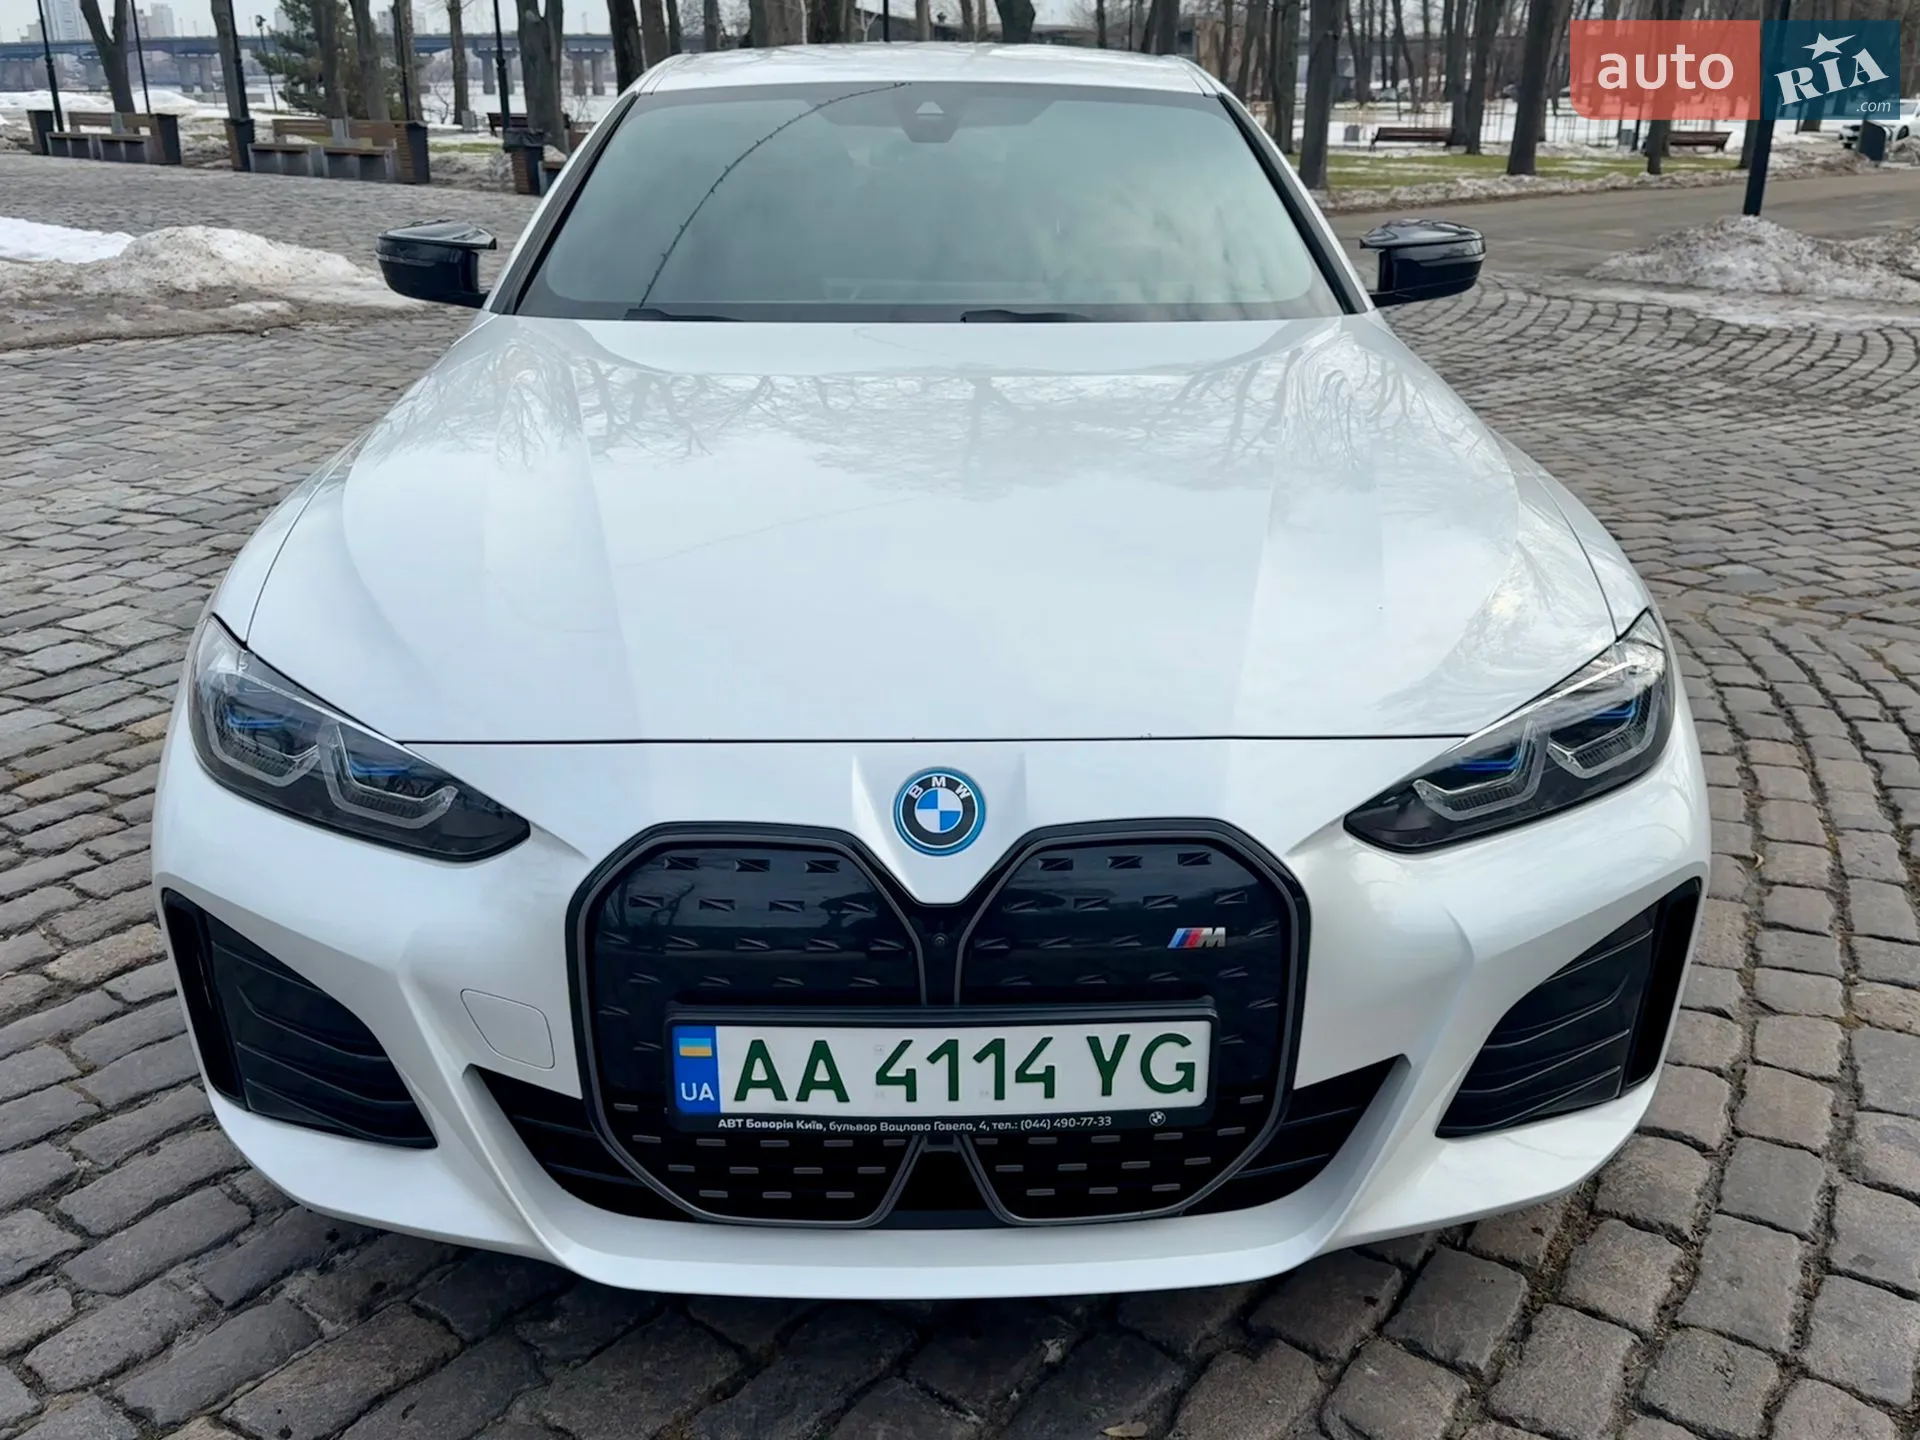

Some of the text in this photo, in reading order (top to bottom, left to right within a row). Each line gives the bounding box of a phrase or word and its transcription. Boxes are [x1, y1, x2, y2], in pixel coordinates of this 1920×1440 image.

[908, 776, 971, 799] BMW
[734, 1033, 1195, 1103] AA 4114 YG
[681, 1082, 715, 1101] UA
[796, 1120, 827, 1132] Київ,
[829, 1121, 877, 1133] бульвар
[979, 1120, 990, 1131] 4,
[992, 1121, 1018, 1130] тел.:
[1020, 1118, 1051, 1131] (044)
[1053, 1116, 1112, 1128] 490-77-33
